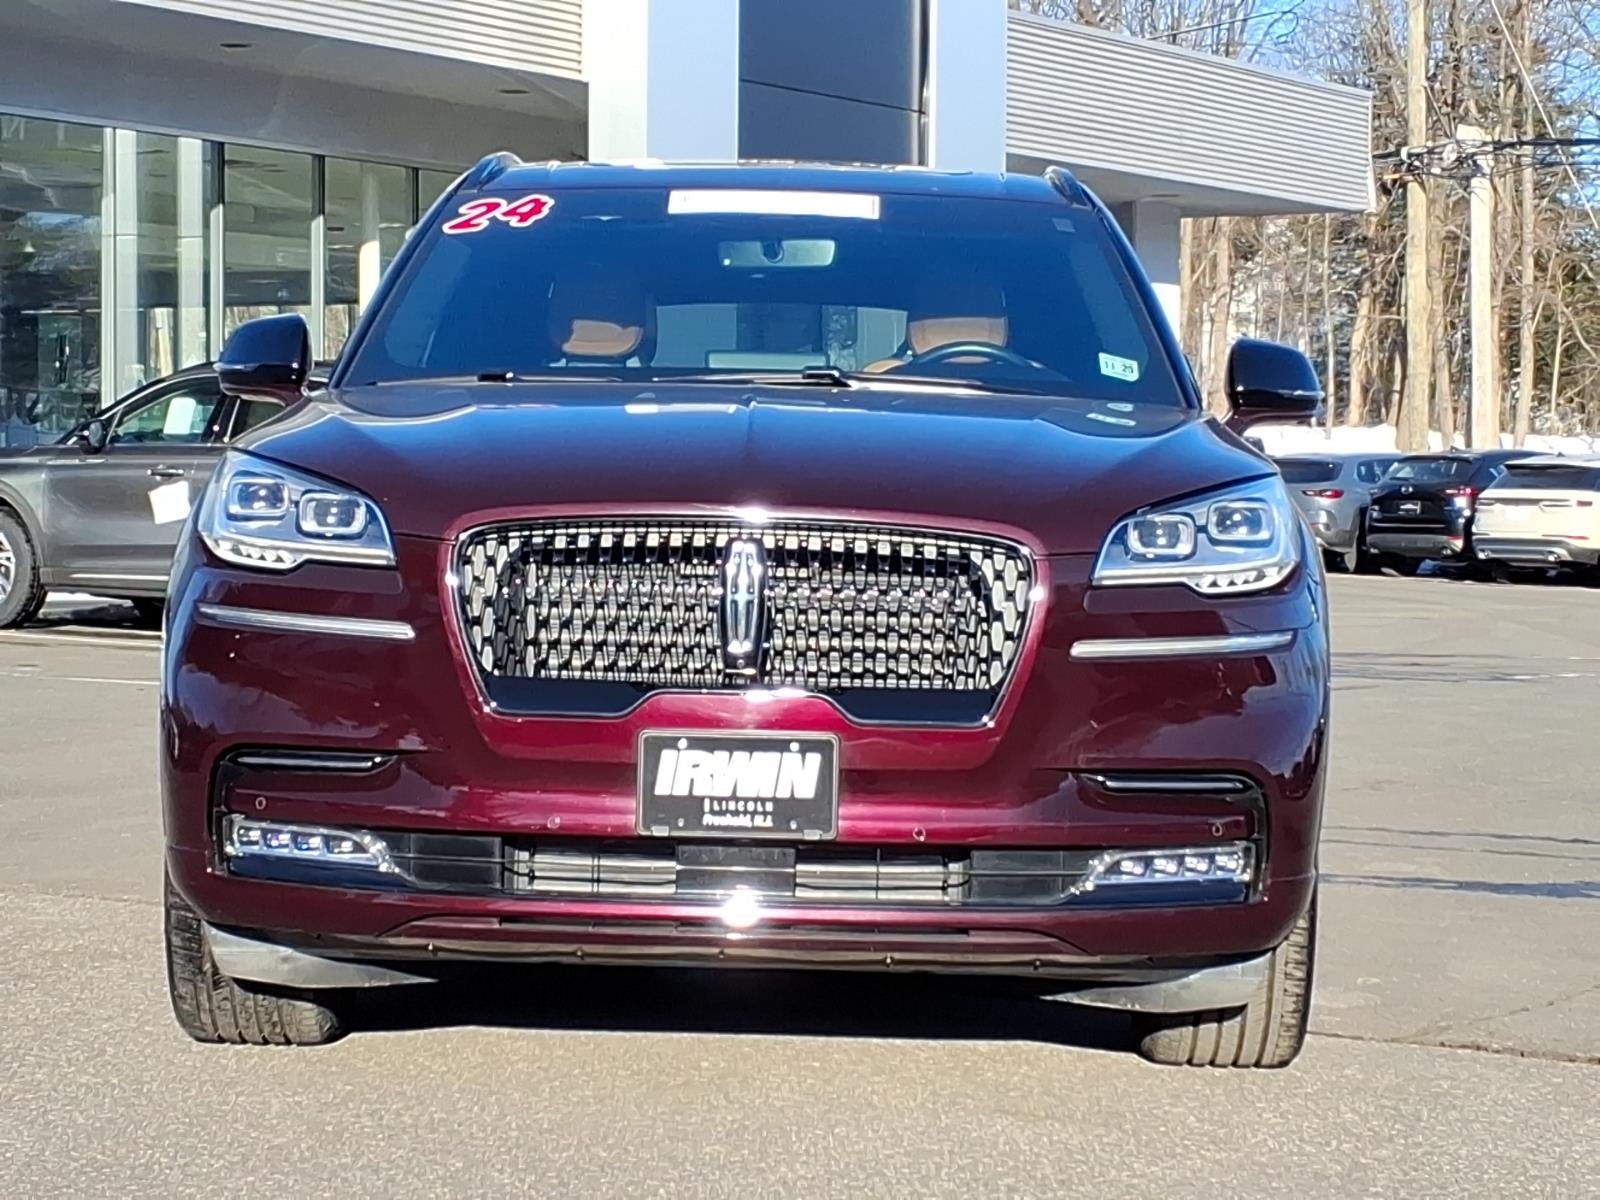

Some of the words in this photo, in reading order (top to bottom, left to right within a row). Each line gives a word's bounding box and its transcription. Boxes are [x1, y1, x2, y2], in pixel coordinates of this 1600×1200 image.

[442, 194, 555, 234] 24
[654, 749, 822, 799] IRWIN
[713, 800, 774, 812] LINCOLN
